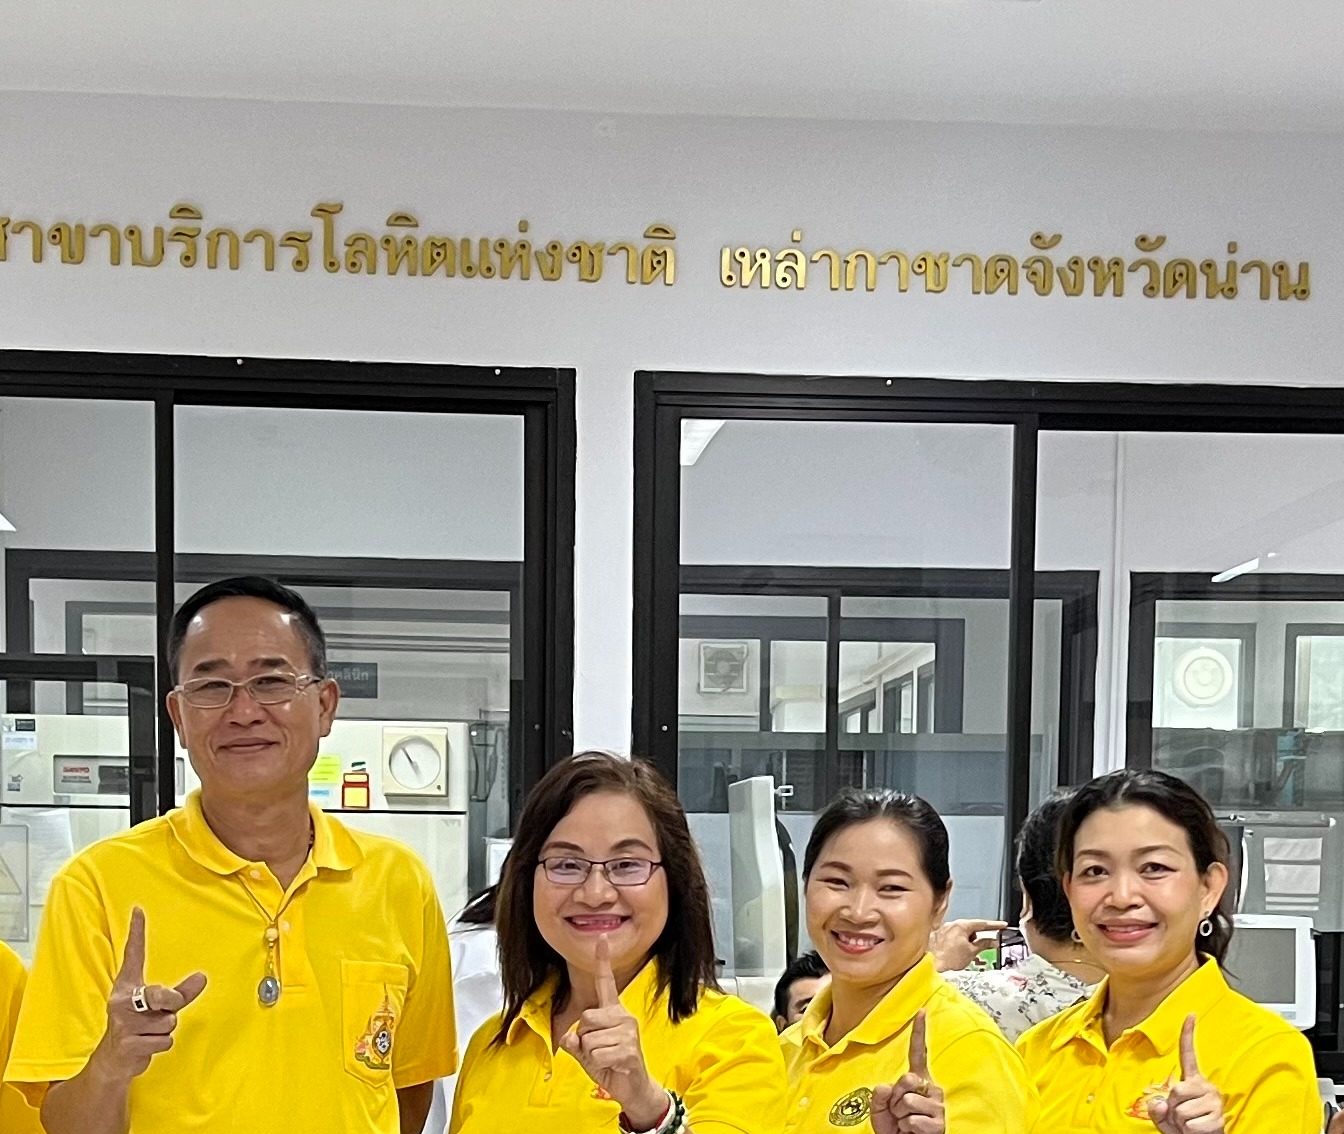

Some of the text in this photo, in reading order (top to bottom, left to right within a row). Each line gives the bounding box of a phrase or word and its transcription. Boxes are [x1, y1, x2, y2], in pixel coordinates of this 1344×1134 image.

[719, 229, 1311, 300] เหล่ากาชาดจังหวัดน่าน
